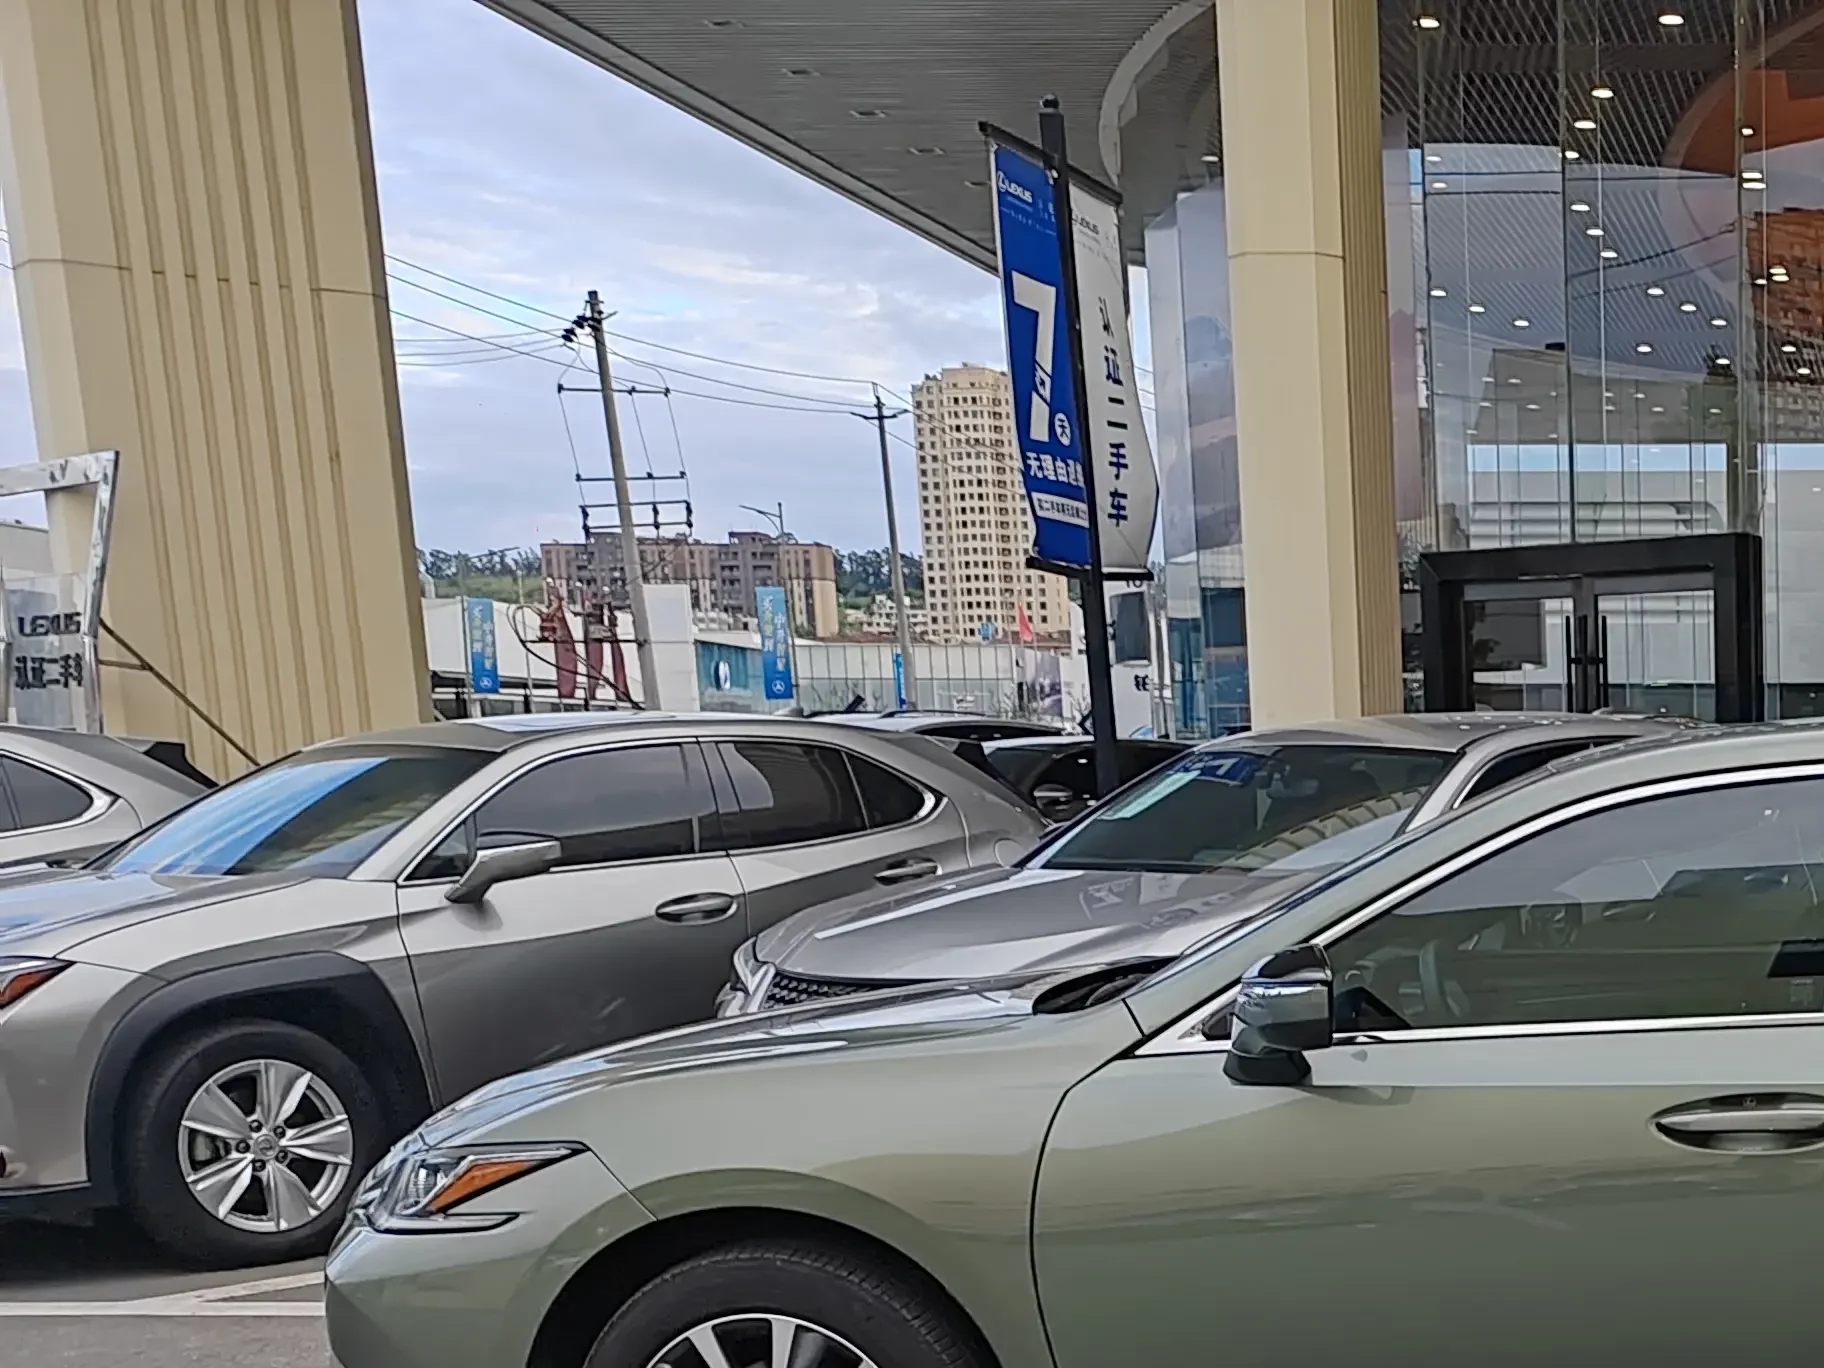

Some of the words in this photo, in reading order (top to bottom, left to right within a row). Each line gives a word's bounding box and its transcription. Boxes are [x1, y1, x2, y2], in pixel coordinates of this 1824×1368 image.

[1006, 180, 1033, 203] LEXUS
[1011, 269, 1057, 443] 7
[1098, 296, 1129, 527] 认证二手车
